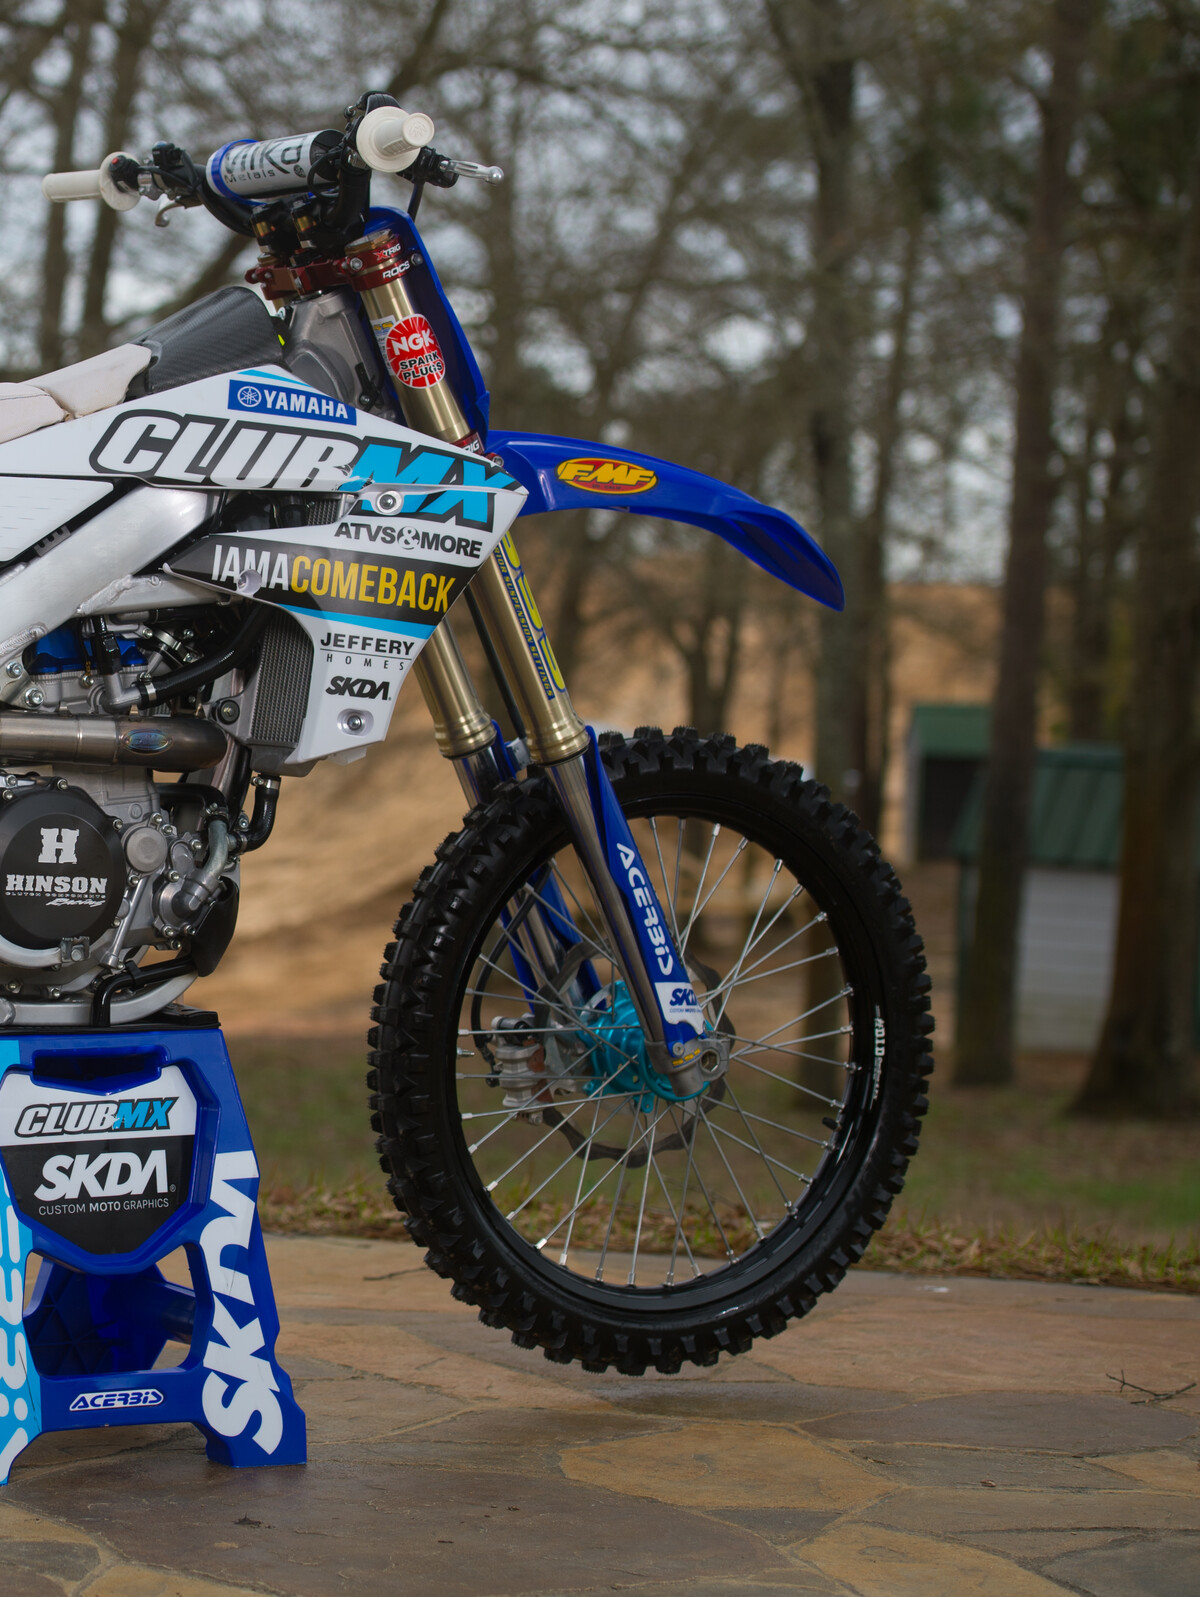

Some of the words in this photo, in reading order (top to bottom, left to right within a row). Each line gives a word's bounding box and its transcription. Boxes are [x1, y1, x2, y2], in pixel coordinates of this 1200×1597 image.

[373, 243, 401, 260] XTRIG
[382, 260, 410, 279] ROCS
[391, 328, 435, 356] NGK
[399, 351, 439, 370] SPARK
[402, 362, 443, 381] PLUGS
[264, 388, 349, 420] YAMAHA
[558, 462, 655, 486] FMF
[320, 632, 415, 656] JEFFERY
[503, 575, 535, 644] SUSPENSION
[529, 645, 555, 698] SETTINGS
[326, 653, 404, 671] HOMES
[325, 675, 389, 700] SKDA
[38, 827, 79, 864] H
[6, 873, 108, 893] HINSON
[615, 842, 674, 976] ACERBIS
[14, 1096, 180, 1138] CLUBMX
[33, 1149, 169, 1202] SKDA
[38, 1203, 87, 1216] CUSTOM
[89, 1200, 121, 1213] MOTO
[123, 1197, 170, 1211] GRAPHICS
[70, 1390, 163, 1411] ACERBIS
